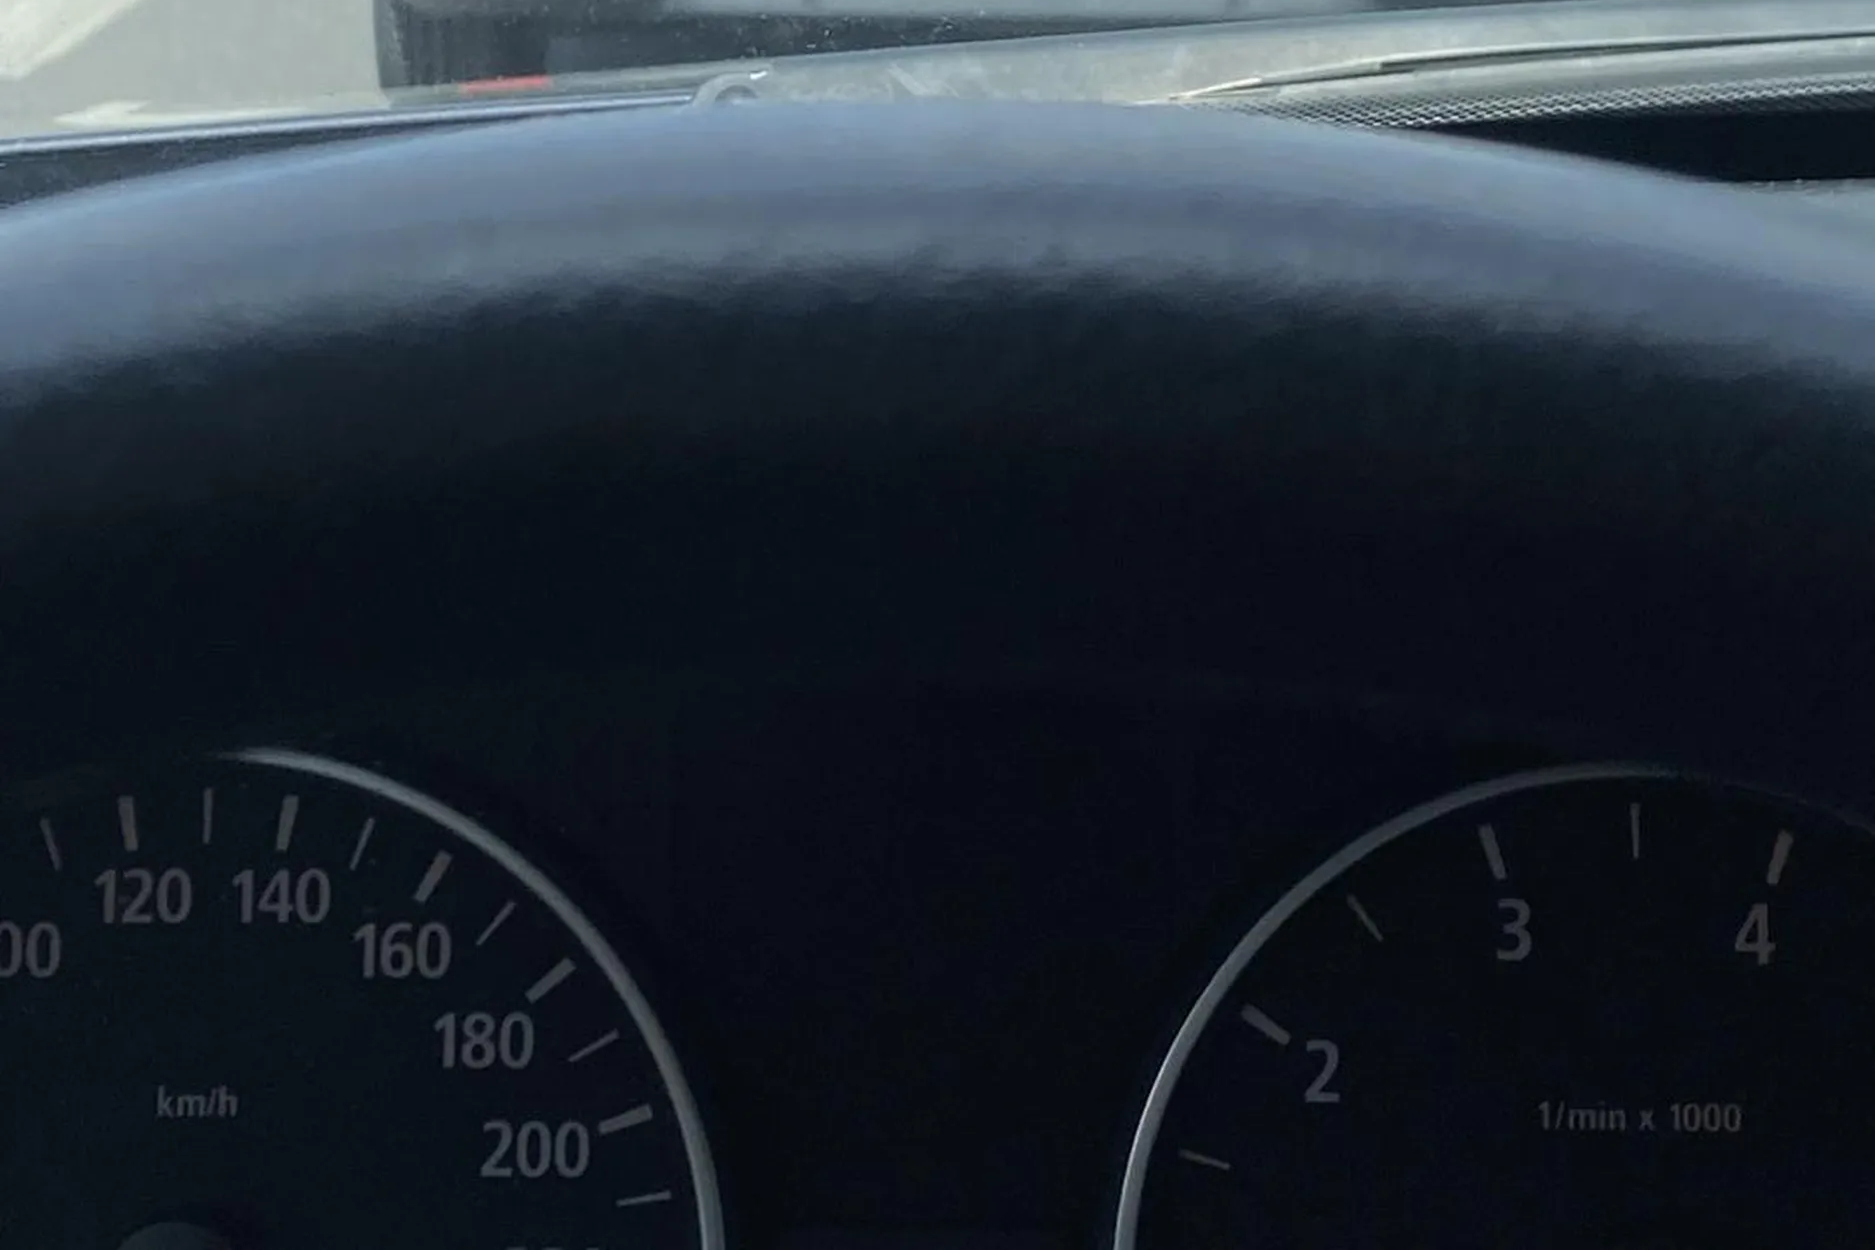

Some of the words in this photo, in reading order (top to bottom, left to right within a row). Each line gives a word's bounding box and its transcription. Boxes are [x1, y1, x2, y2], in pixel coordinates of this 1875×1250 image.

[94, 867, 193, 924] 120
[231, 867, 331, 924] 140
[353, 921, 452, 979] 160
[1496, 898, 1533, 962] 3
[1734, 902, 1777, 966] 4
[434, 1011, 535, 1069] 180
[1304, 1039, 1341, 1103] 2
[156, 1084, 238, 1118] km/h
[1538, 1100, 1627, 1132] 1/min
[1670, 1103, 1742, 1133] 1000
[480, 1119, 590, 1178] 200
